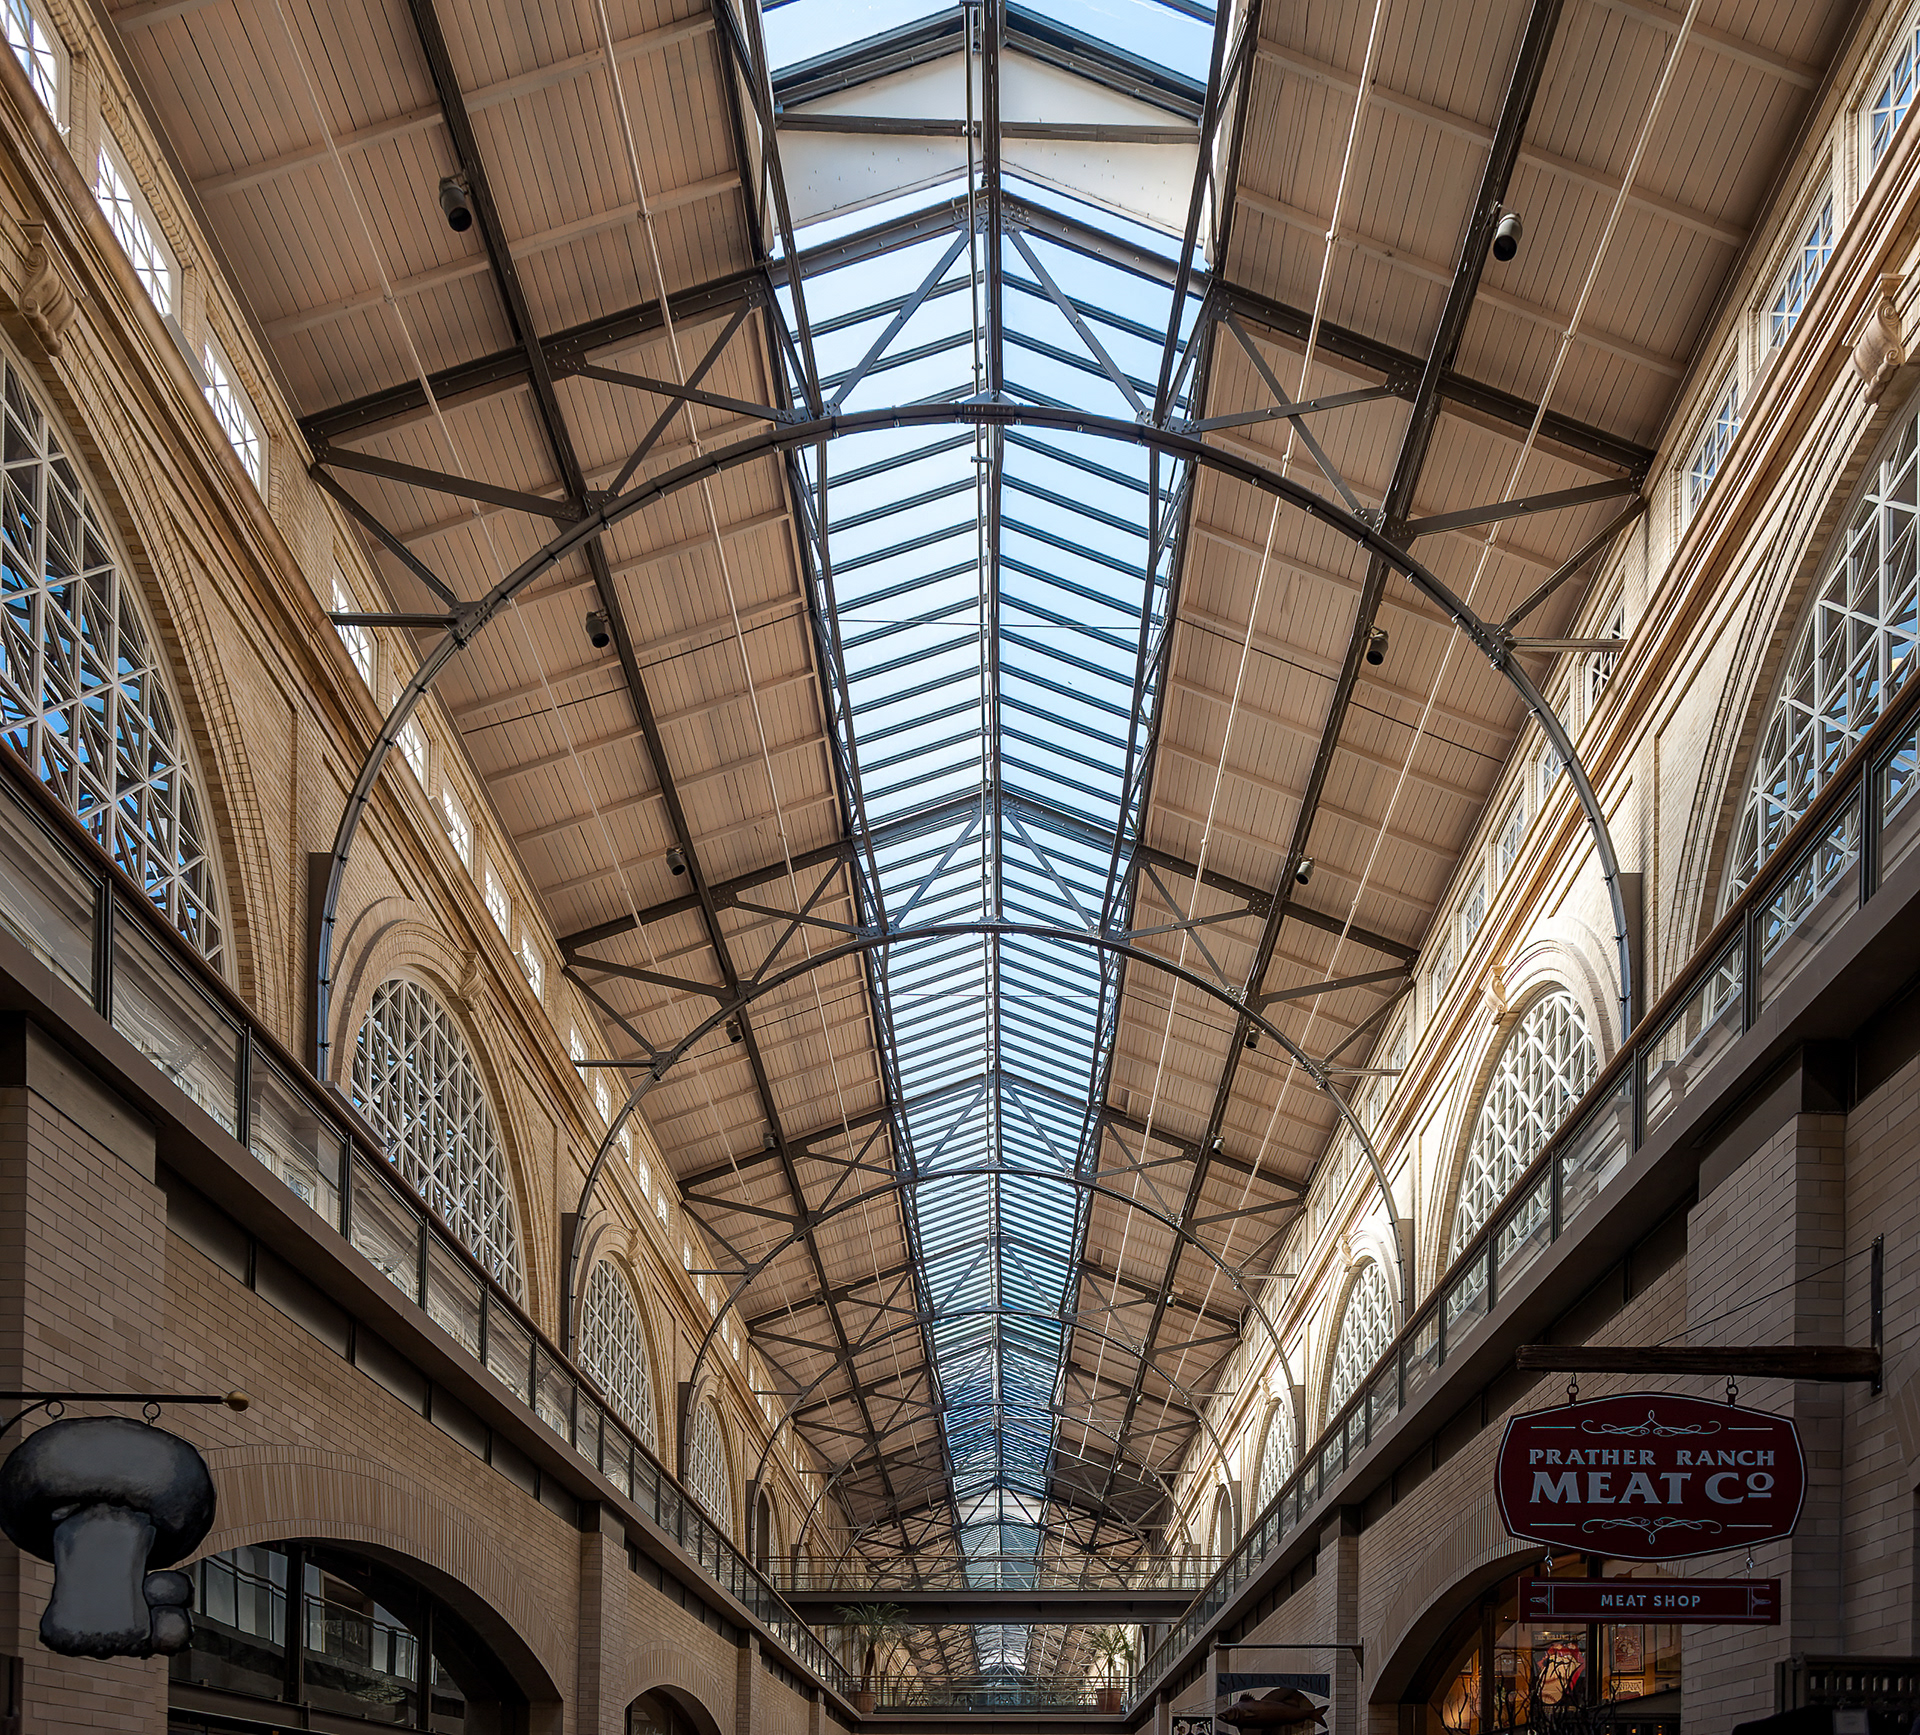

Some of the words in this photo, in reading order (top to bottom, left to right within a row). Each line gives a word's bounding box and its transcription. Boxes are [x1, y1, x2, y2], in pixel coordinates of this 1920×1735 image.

[1529, 1449, 1656, 1466] PRATHER
[1676, 1450, 1775, 1466] RANCH
[1529, 1471, 1692, 1504] MEAT
[1601, 1594, 1646, 1607] MEAT
[1653, 1595, 1701, 1608] SHOP
[1218, 1675, 1247, 1691] SAN
[1250, 1675, 1328, 1694] FRANCISCO
